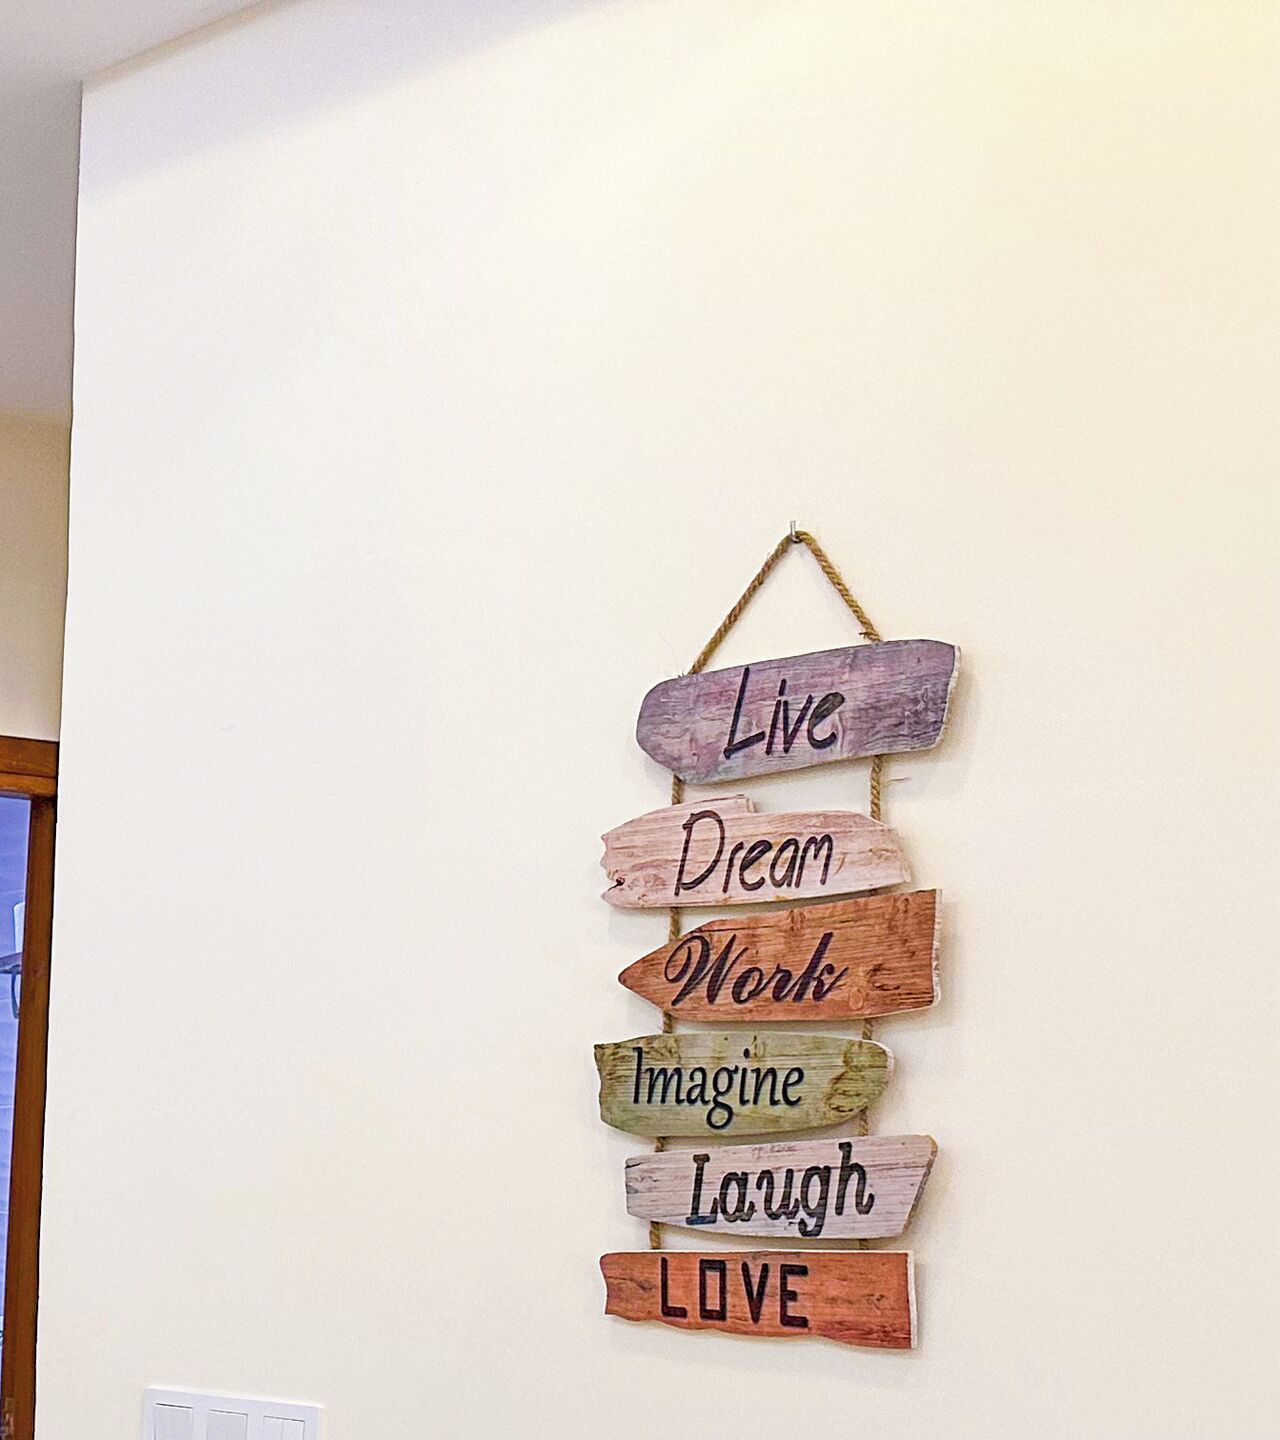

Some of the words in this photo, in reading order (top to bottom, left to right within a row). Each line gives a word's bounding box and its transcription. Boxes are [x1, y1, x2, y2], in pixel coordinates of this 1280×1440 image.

[723, 666, 846, 759] Live
[673, 809, 834, 896] Dream
[664, 931, 848, 1007] Work
[632, 1046, 805, 1130] Imagine
[685, 1141, 876, 1237] Laugh
[660, 1256, 809, 1329] LOVE
